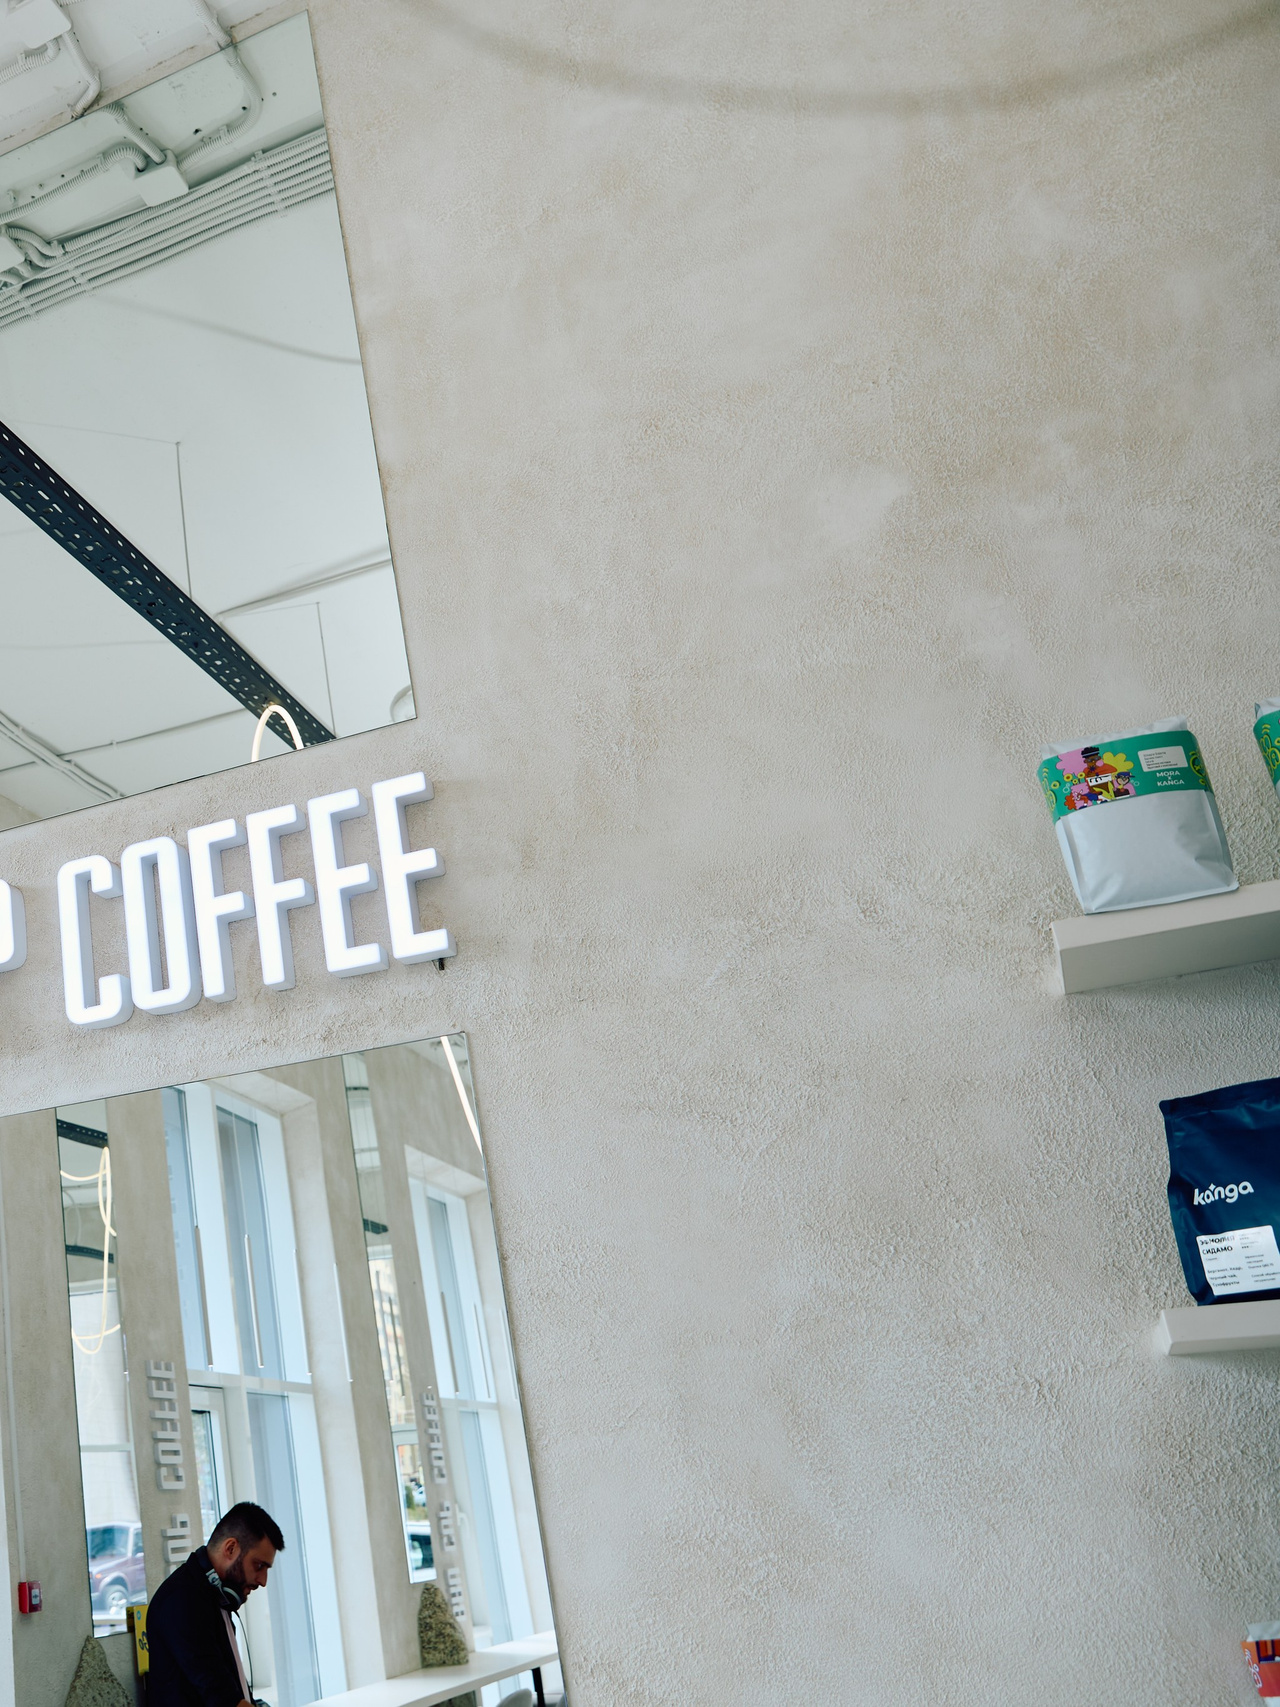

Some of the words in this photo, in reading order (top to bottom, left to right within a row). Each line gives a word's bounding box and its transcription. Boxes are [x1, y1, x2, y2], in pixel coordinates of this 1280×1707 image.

[1156, 770, 1180, 778] MORA
[57, 771, 457, 1030] COFFEE
[1193, 1181, 1255, 1206] kanga
[1202, 1245, 1233, 1255] СИДАМО
